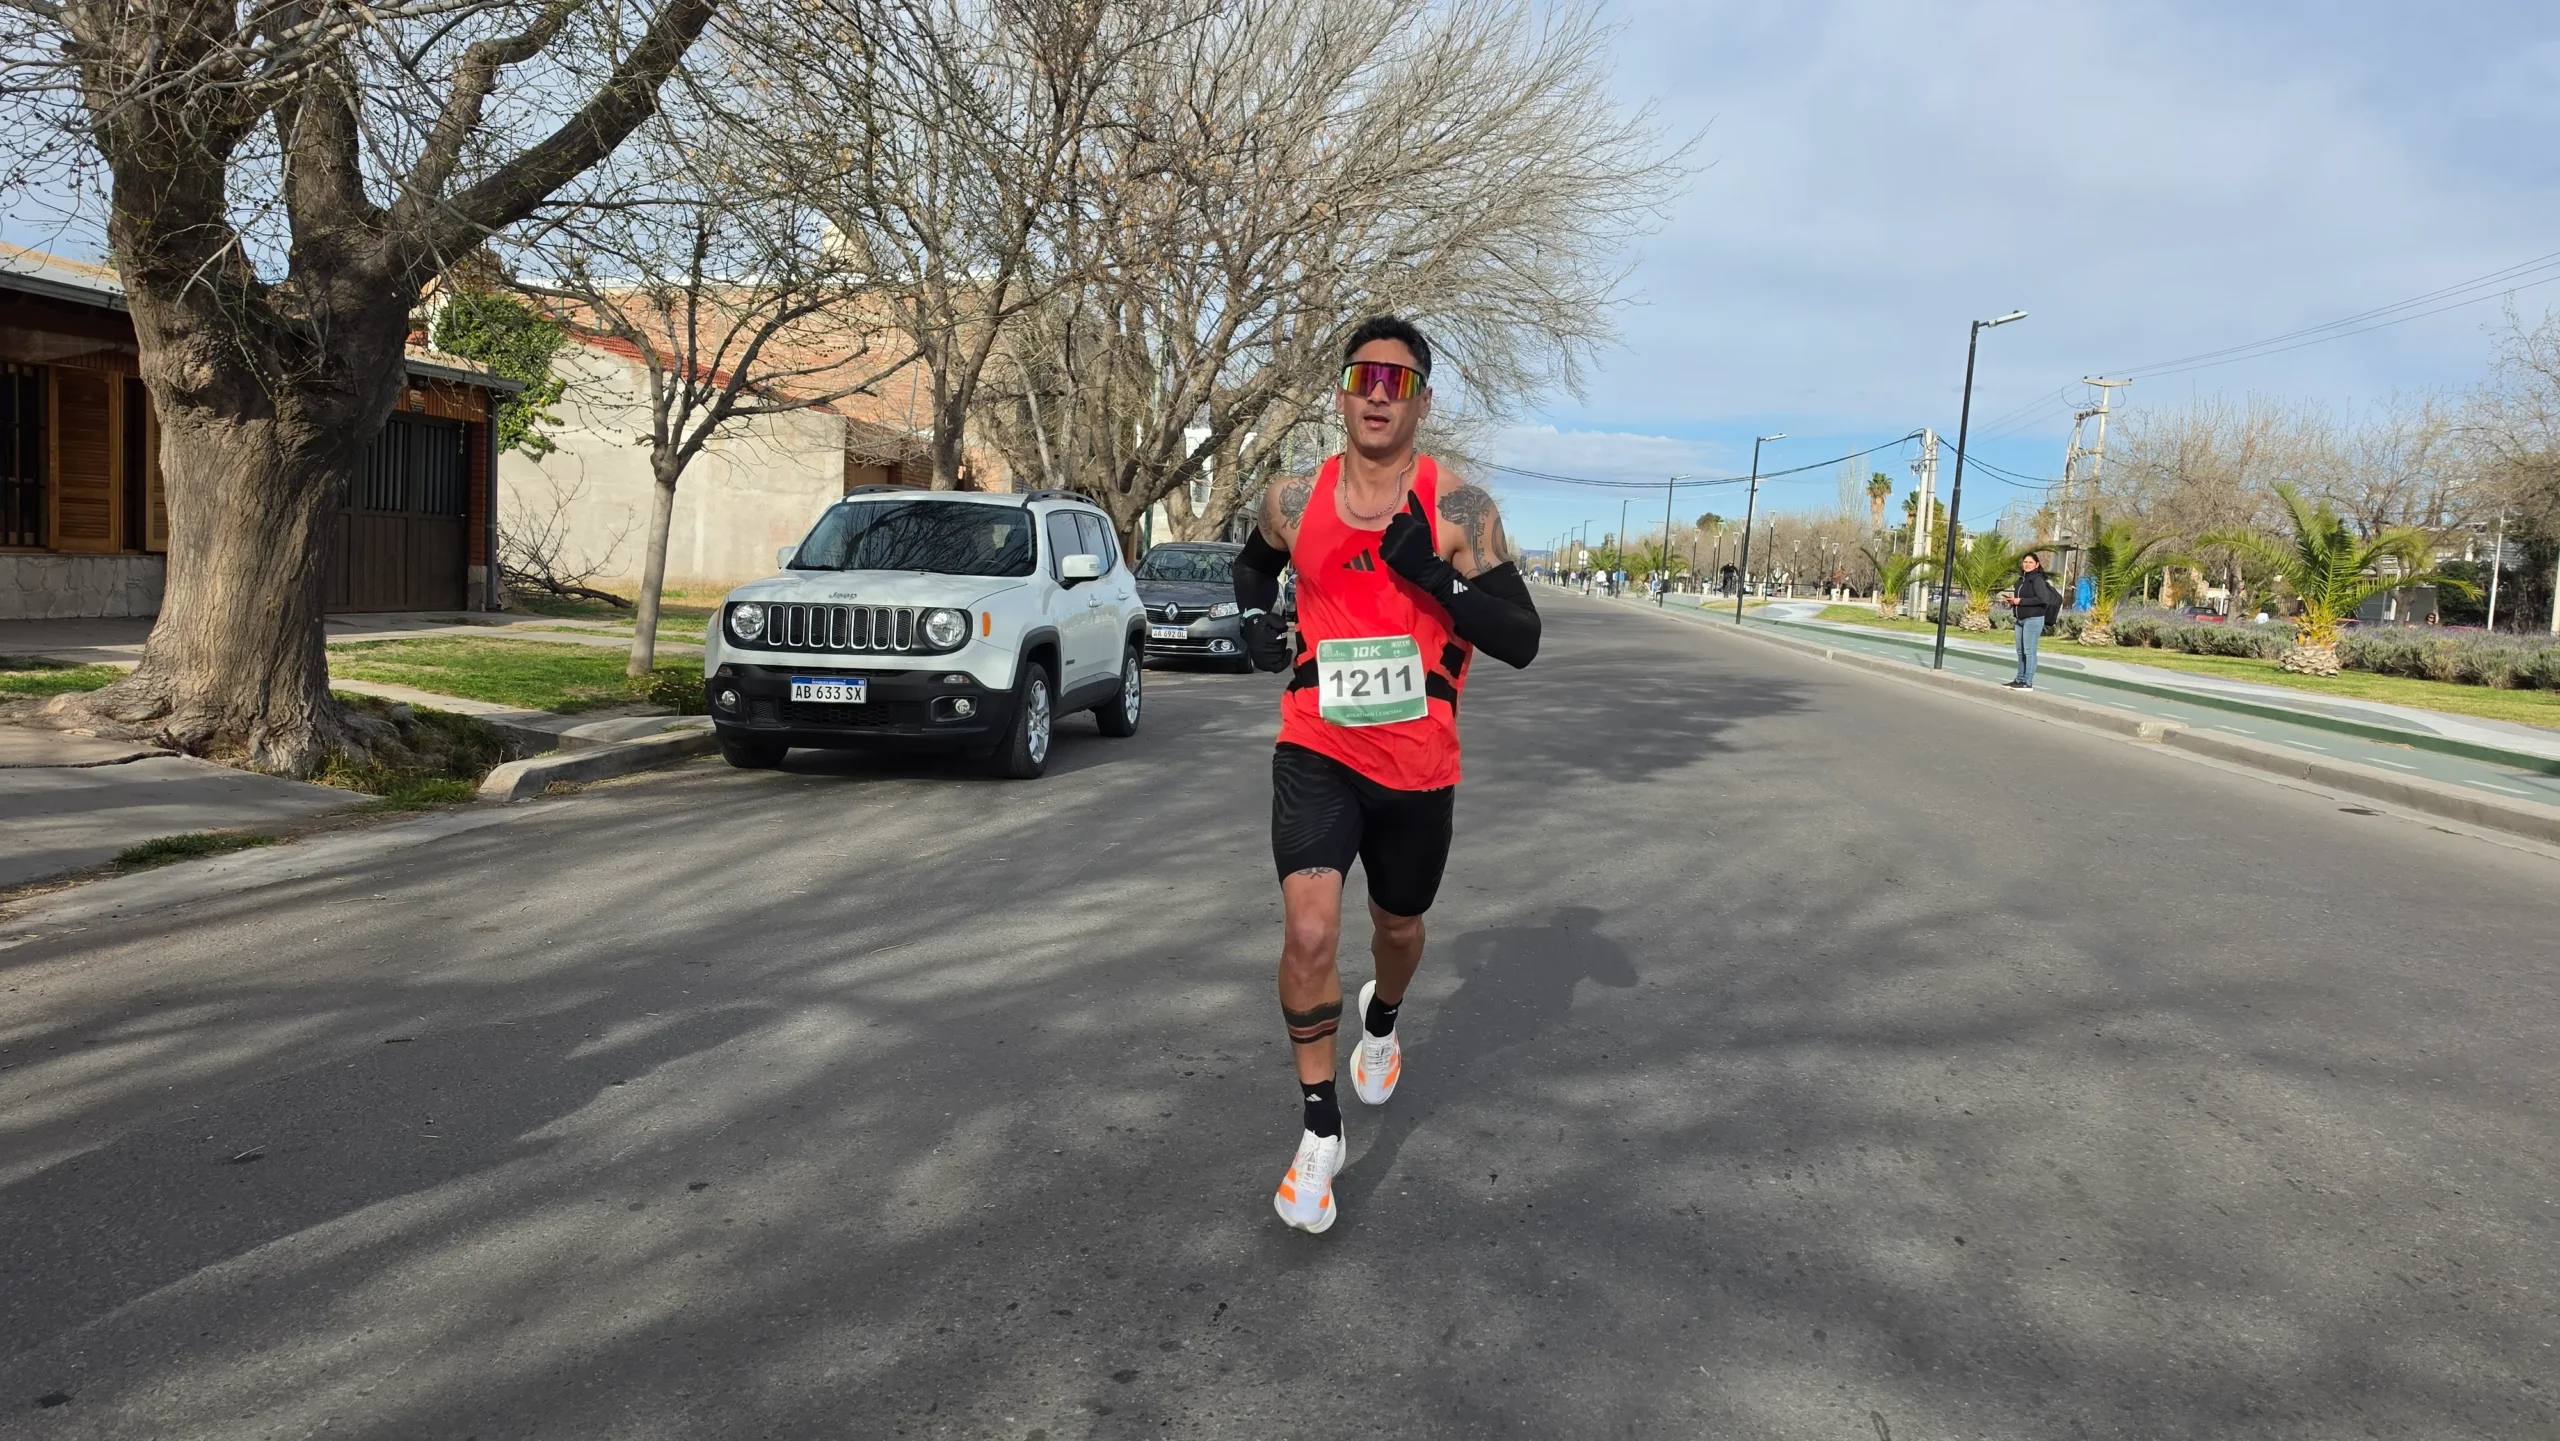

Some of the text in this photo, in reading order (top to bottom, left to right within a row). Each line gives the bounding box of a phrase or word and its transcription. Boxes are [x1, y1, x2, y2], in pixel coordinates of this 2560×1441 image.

[828, 592, 858, 600] Jeep
[1164, 630, 1176, 638] 692
[1353, 645, 1381, 658] 10K
[1329, 664, 1412, 698] 1211
[795, 685, 861, 700] AB 633 SX
